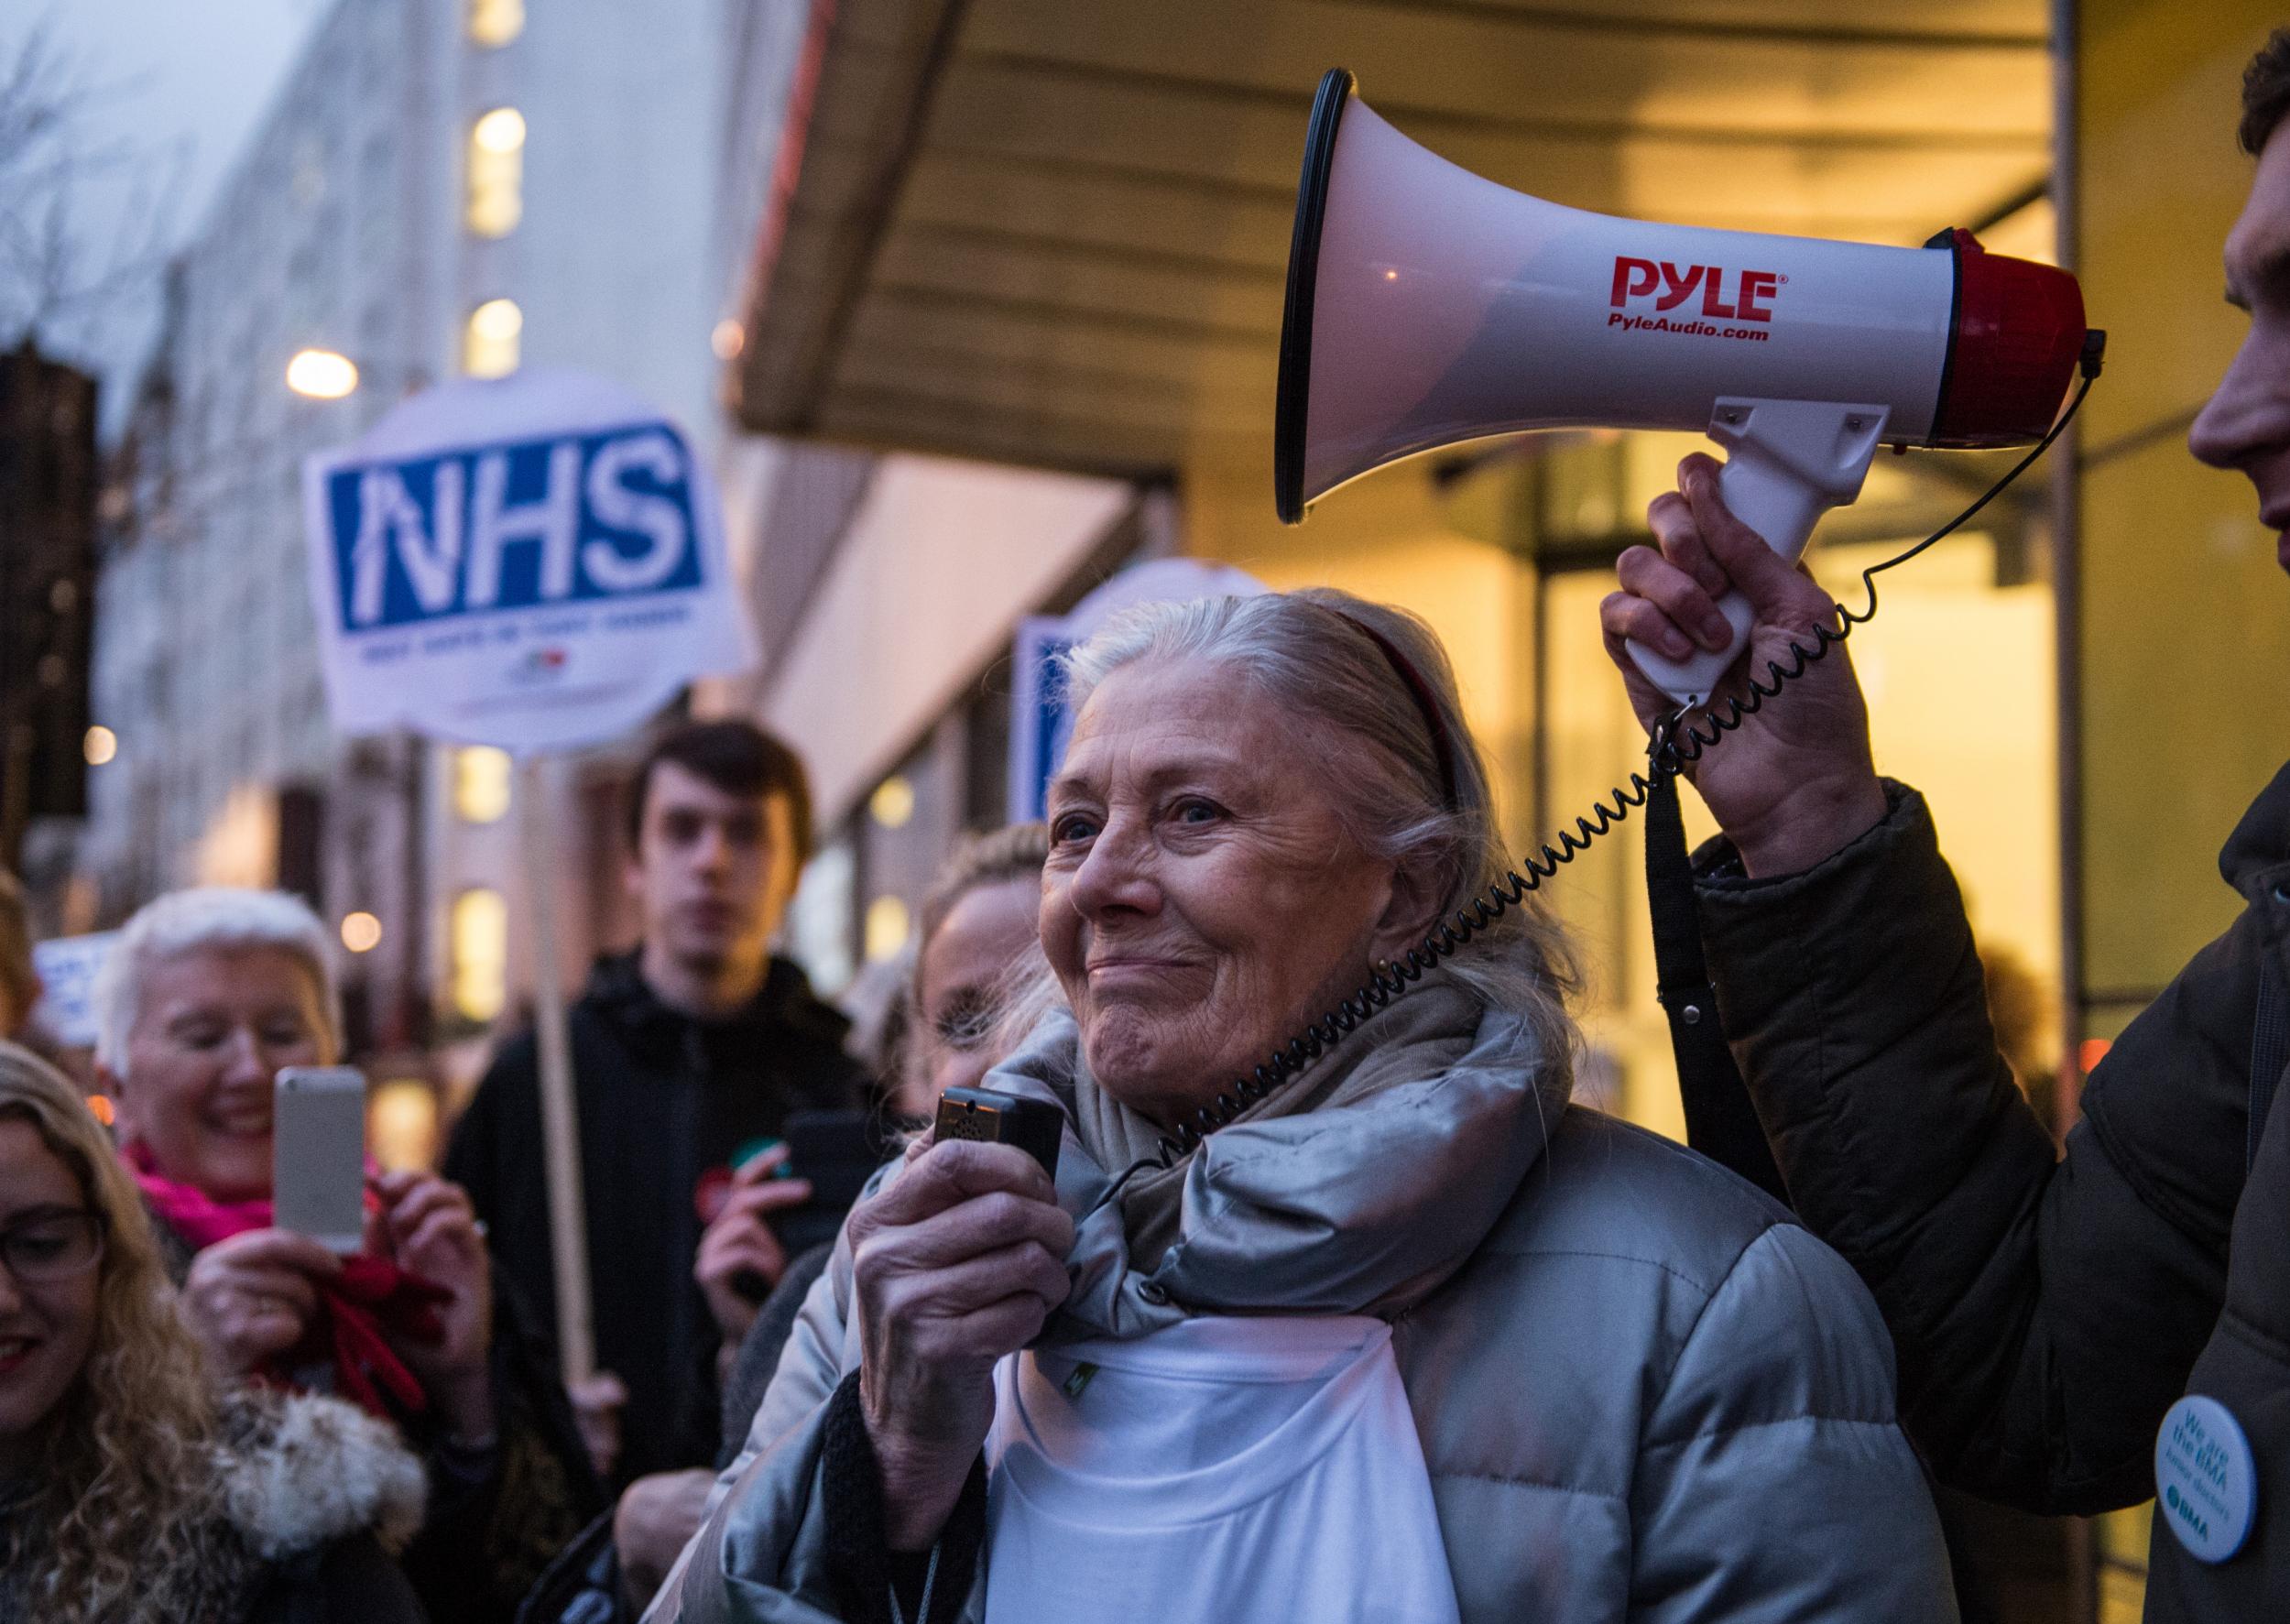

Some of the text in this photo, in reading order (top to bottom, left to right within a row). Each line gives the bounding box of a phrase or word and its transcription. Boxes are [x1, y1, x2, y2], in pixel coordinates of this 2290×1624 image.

[1610, 256, 1777, 322] PYLE
[1608, 312, 1770, 342] PyleAudio.com
[350, 432, 687, 625] NHS
[2186, 1409, 2205, 1441] We
